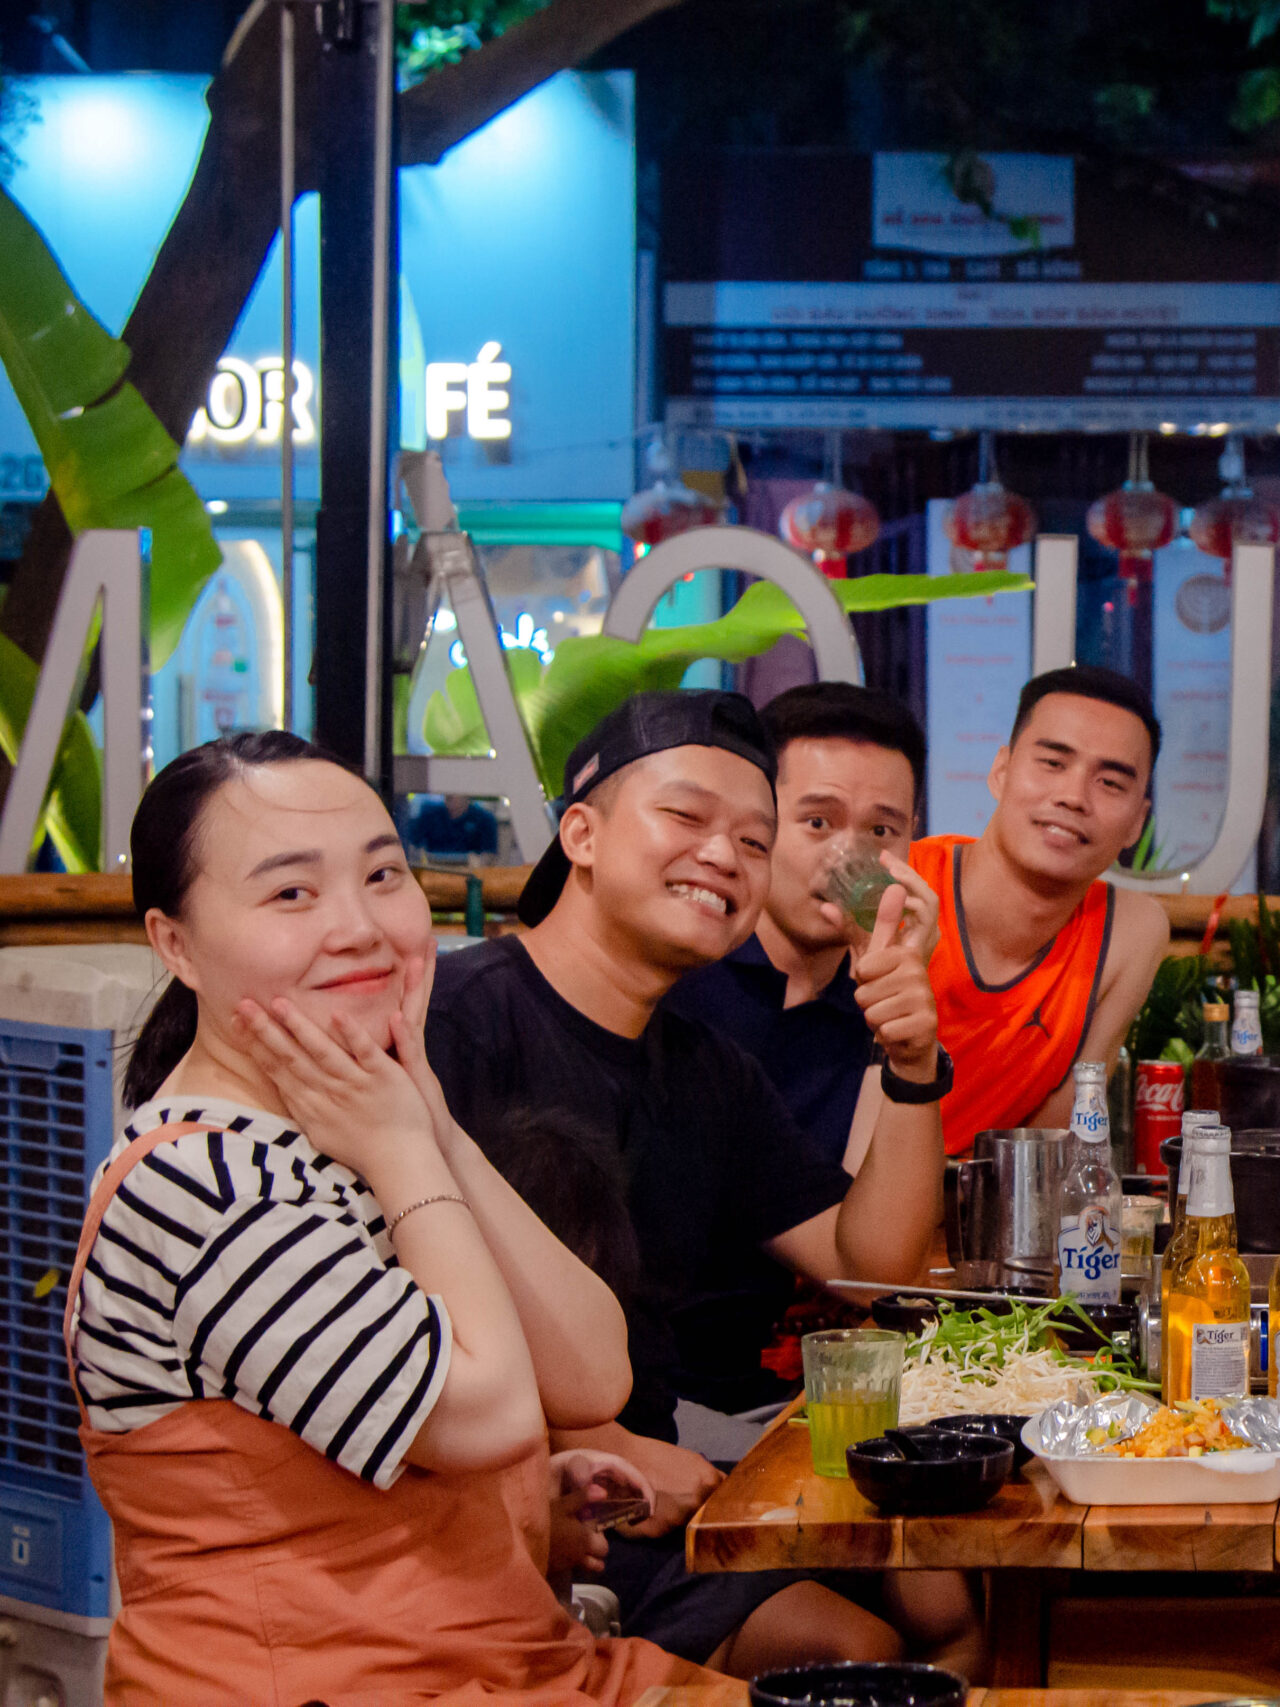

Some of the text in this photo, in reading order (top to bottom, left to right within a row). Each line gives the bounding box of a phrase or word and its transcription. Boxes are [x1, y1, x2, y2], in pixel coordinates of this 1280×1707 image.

[1075, 1111, 1108, 1132] Tiger
[1062, 1245, 1121, 1281] Tiger
[1207, 1329, 1235, 1344] Tiger
